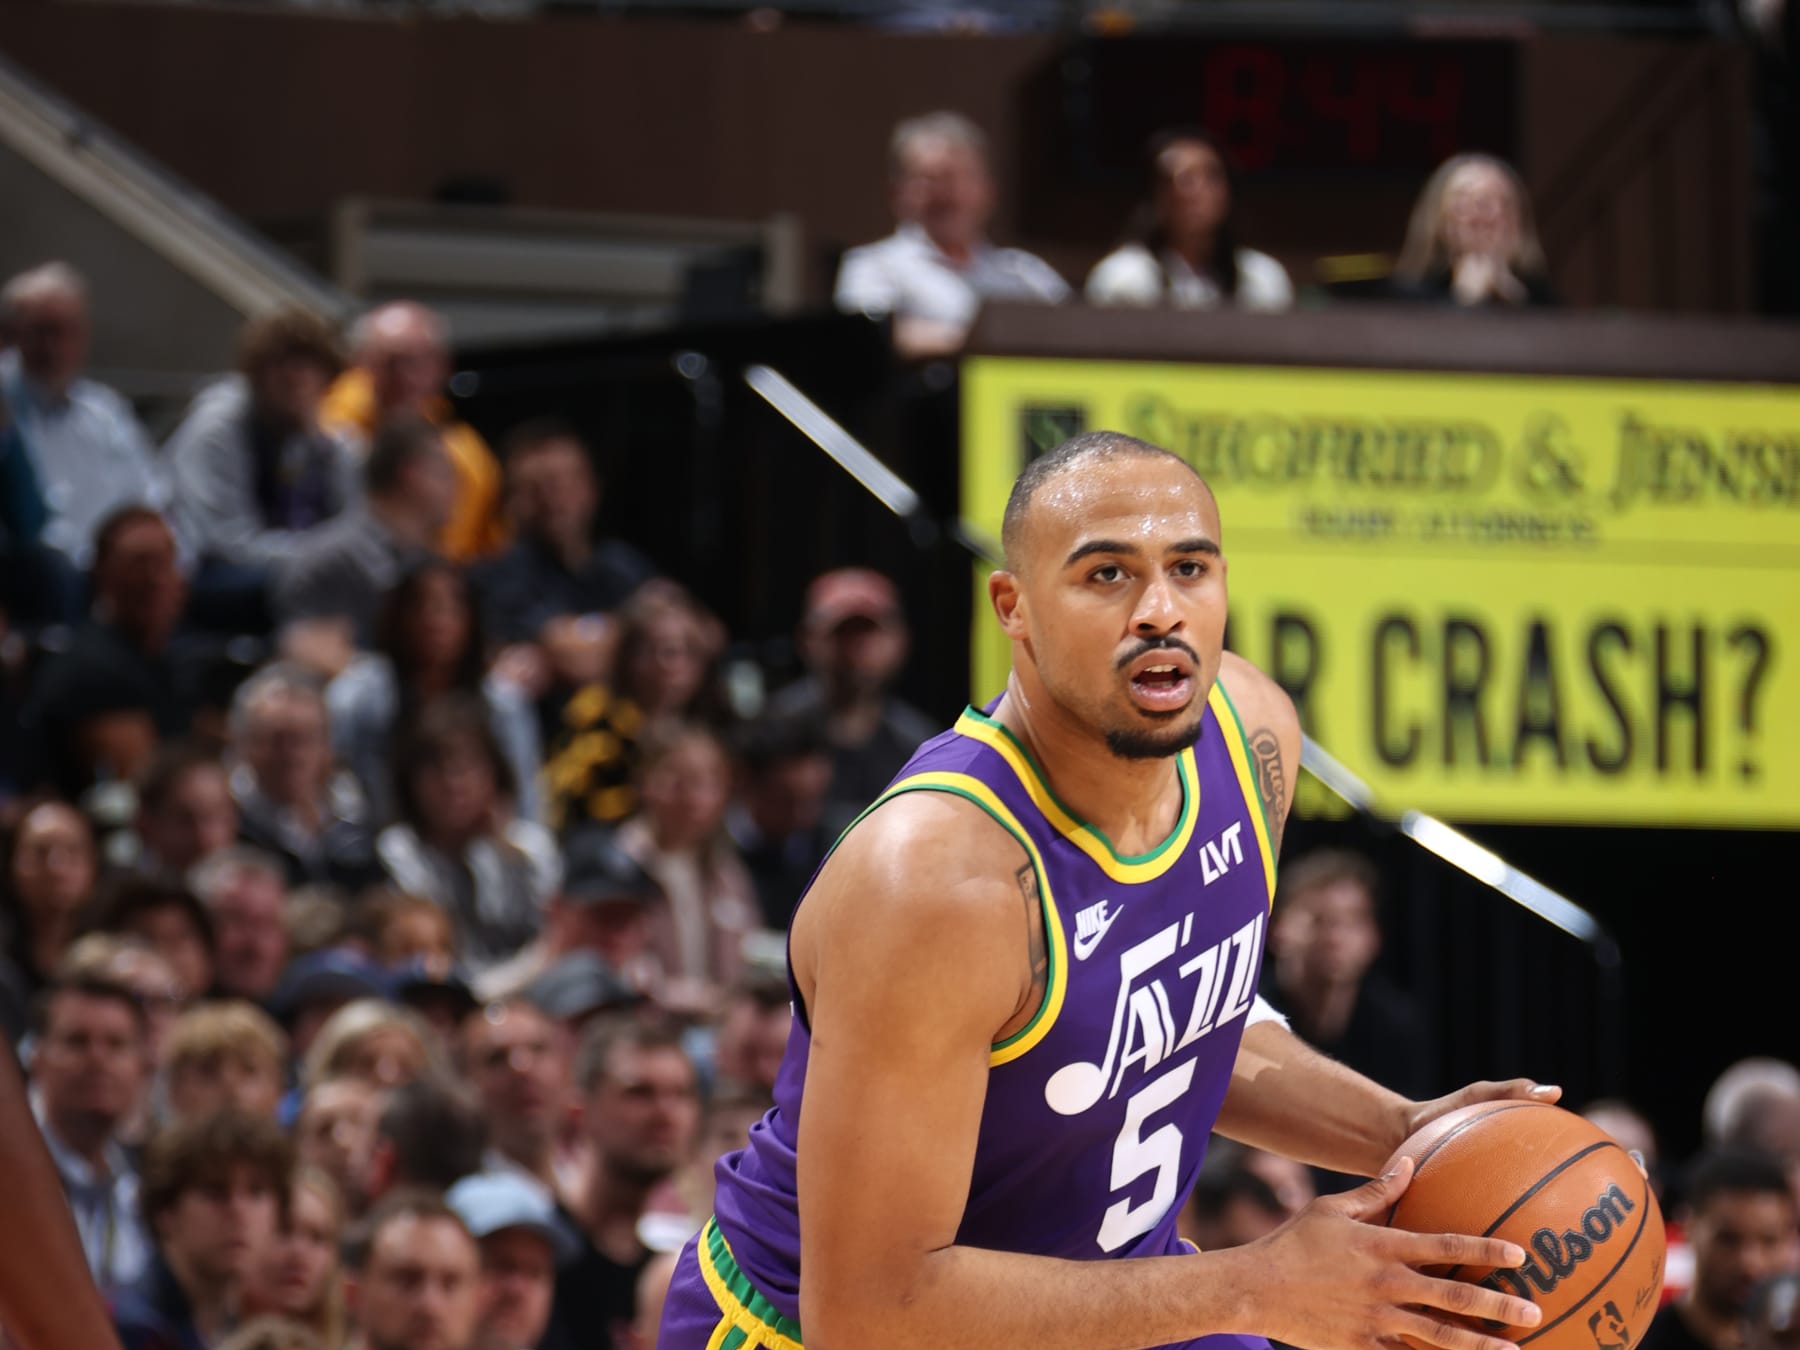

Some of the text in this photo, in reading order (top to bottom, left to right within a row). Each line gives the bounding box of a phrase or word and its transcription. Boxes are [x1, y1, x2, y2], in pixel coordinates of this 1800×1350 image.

[1513, 410, 1586, 500] &
[1370, 610, 1772, 778] CRASH?
[1199, 820, 1244, 887] LVT
[1075, 899, 1108, 940] NIKE
[1097, 1057, 1197, 1253] 5
